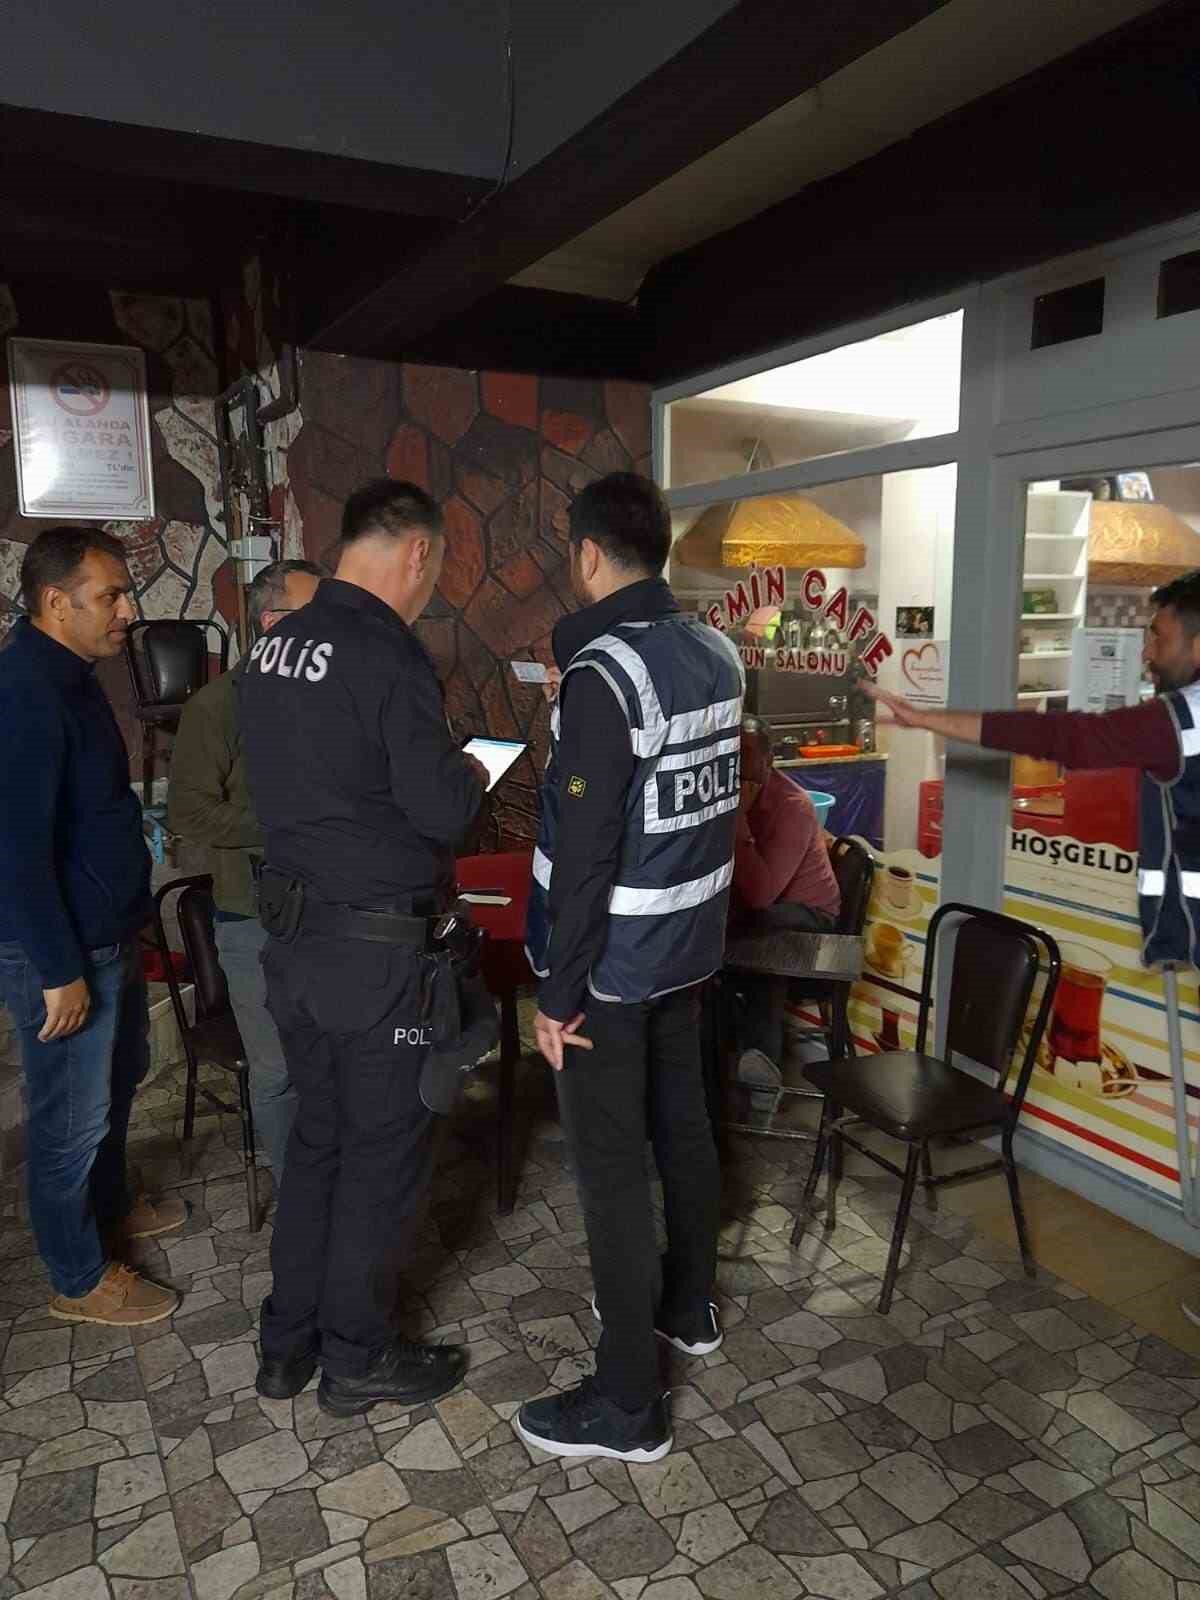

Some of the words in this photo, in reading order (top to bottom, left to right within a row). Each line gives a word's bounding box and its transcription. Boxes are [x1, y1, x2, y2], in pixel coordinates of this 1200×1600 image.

[803, 569, 894, 676] CAFE
[775, 650, 846, 674] SALONU
[674, 757, 740, 812] POLİ
[1011, 831, 1134, 874] HOŞGELD
[394, 1027, 432, 1045] POL
